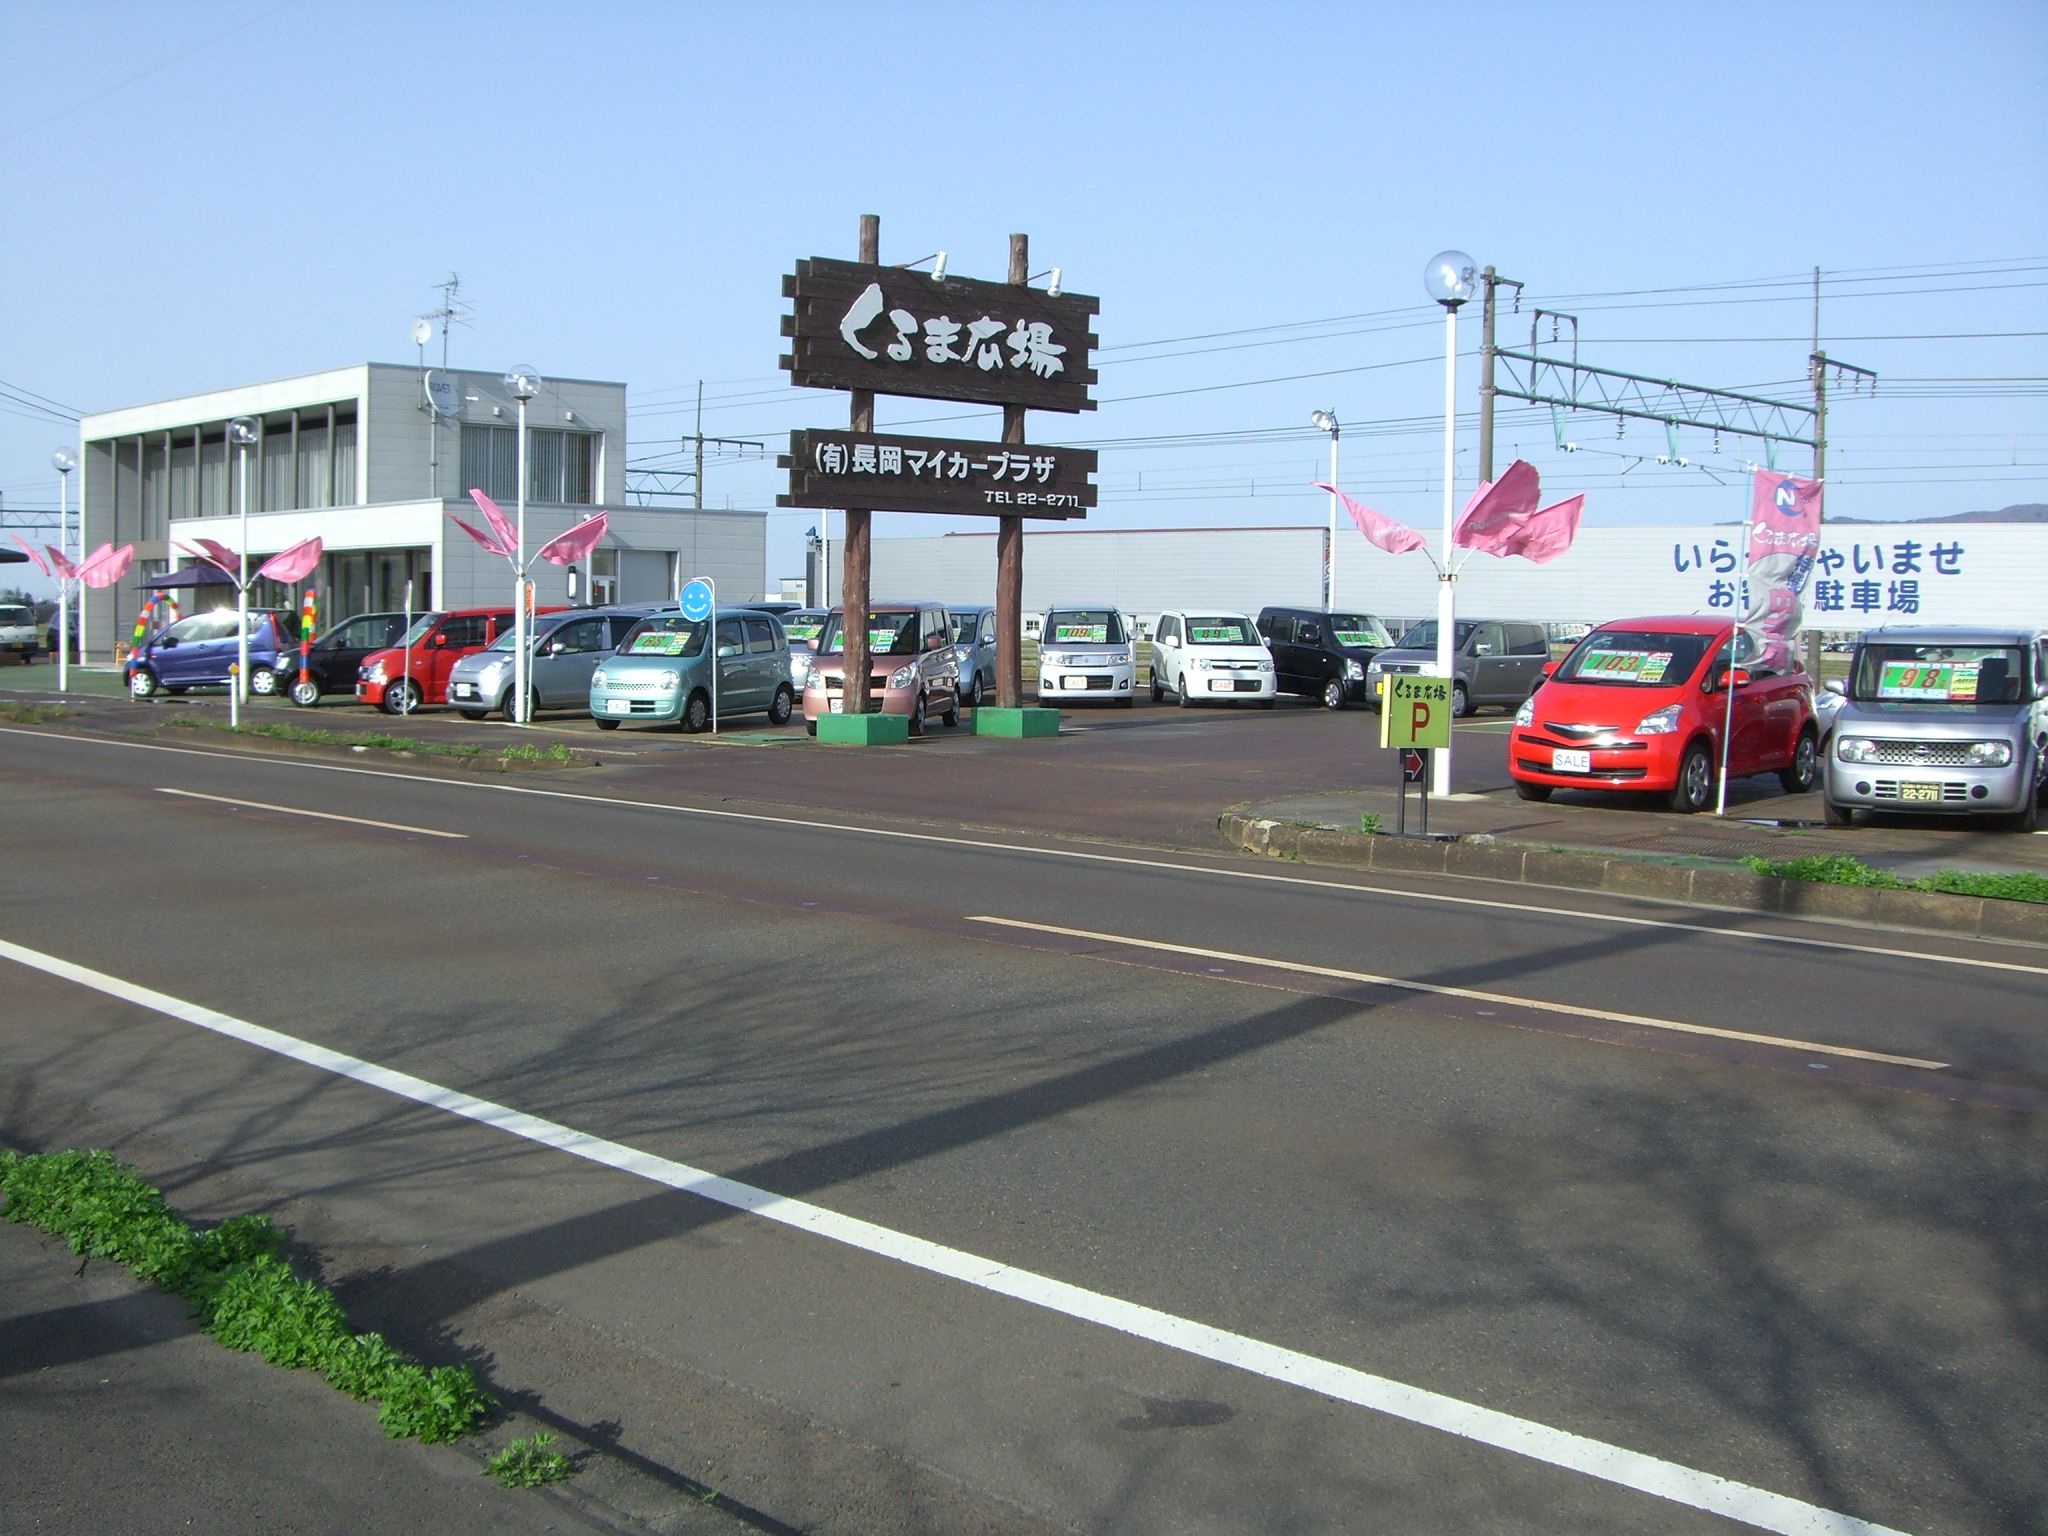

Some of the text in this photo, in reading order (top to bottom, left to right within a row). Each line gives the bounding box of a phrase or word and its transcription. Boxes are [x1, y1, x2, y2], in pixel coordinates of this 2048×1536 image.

[840, 283, 1067, 379] くるま広場
[815, 442, 1055, 483] (有)長岡マイカープラザ
[984, 490, 1079, 507] TEL 22-2711
[1776, 487, 1796, 506] N
[1593, 655, 1640, 672] 103
[1897, 668, 1941, 689] 98
[1395, 678, 1447, 701] くるま広場
[1411, 702, 1431, 742] P
[1555, 754, 1589, 768] SALE
[1902, 788, 1938, 801] 22-2711
